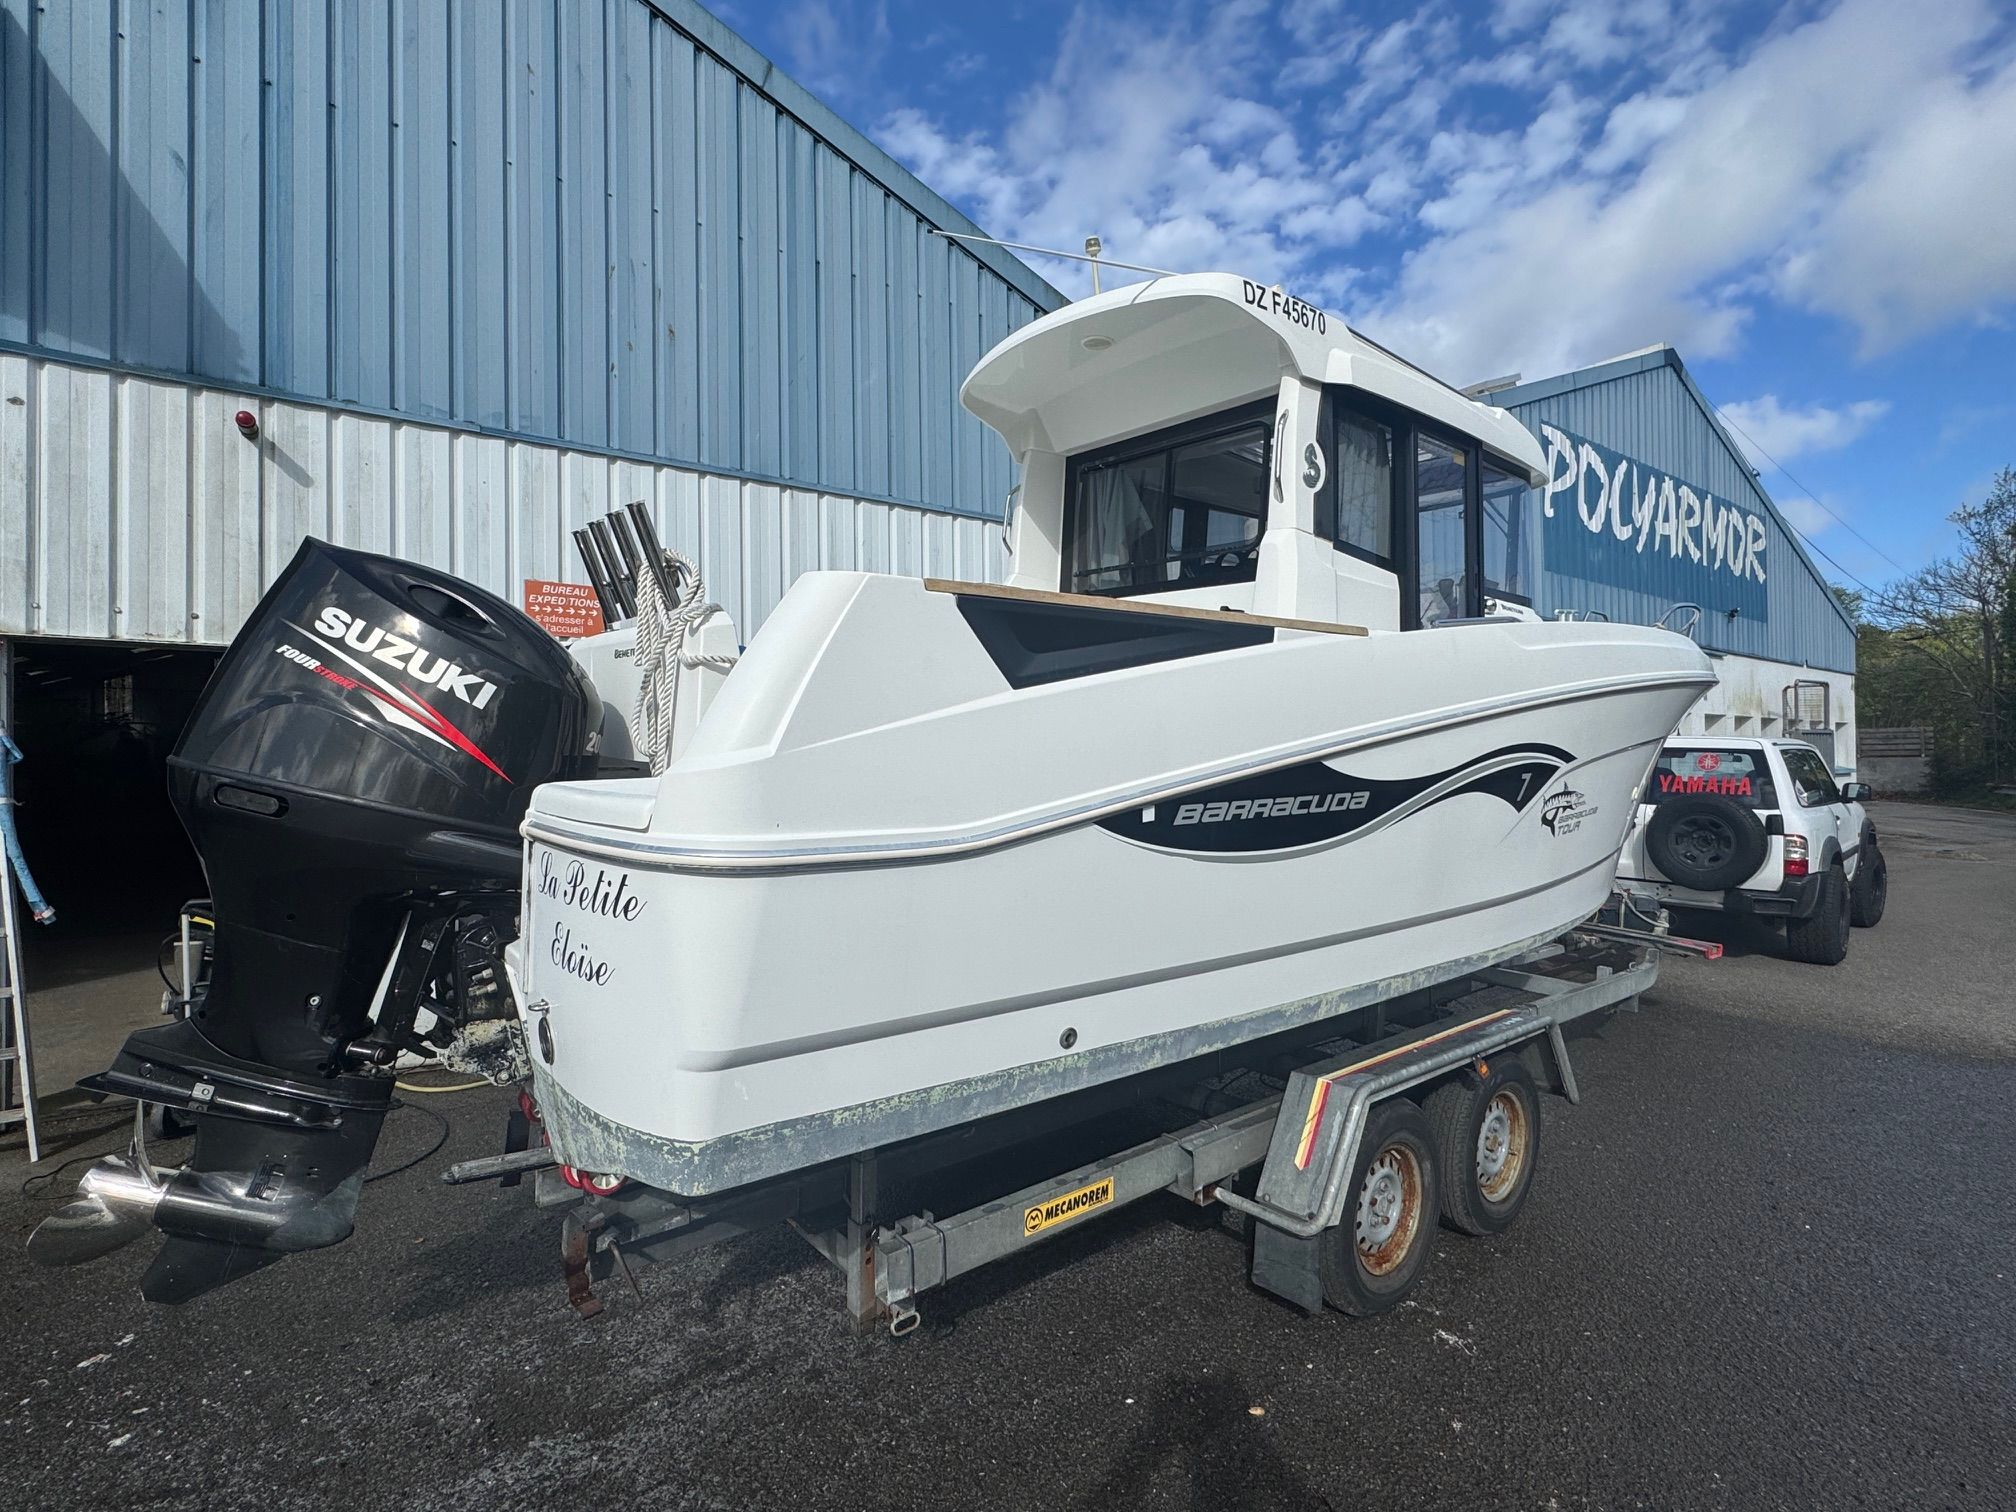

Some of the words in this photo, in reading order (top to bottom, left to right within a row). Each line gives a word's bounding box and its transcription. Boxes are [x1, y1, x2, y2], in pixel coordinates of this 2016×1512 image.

[1243, 280, 1268, 311] DZ
[1272, 290, 1326, 335] F45670
[1541, 423, 1767, 584] POLYARMOR
[542, 584, 589, 597] BUREAU
[535, 614, 585, 626] s'adresser
[587, 616, 594, 626] à
[545, 622, 584, 634] l'accueil
[314, 606, 498, 710] SUZUKI
[1516, 772, 1532, 802] 7
[1659, 774, 1752, 796] YAMAHA
[538, 851, 561, 900] La
[563, 859, 648, 922] Petite
[551, 921, 616, 987] Eloïse
[1044, 1183, 1110, 1223] MECANOREM
